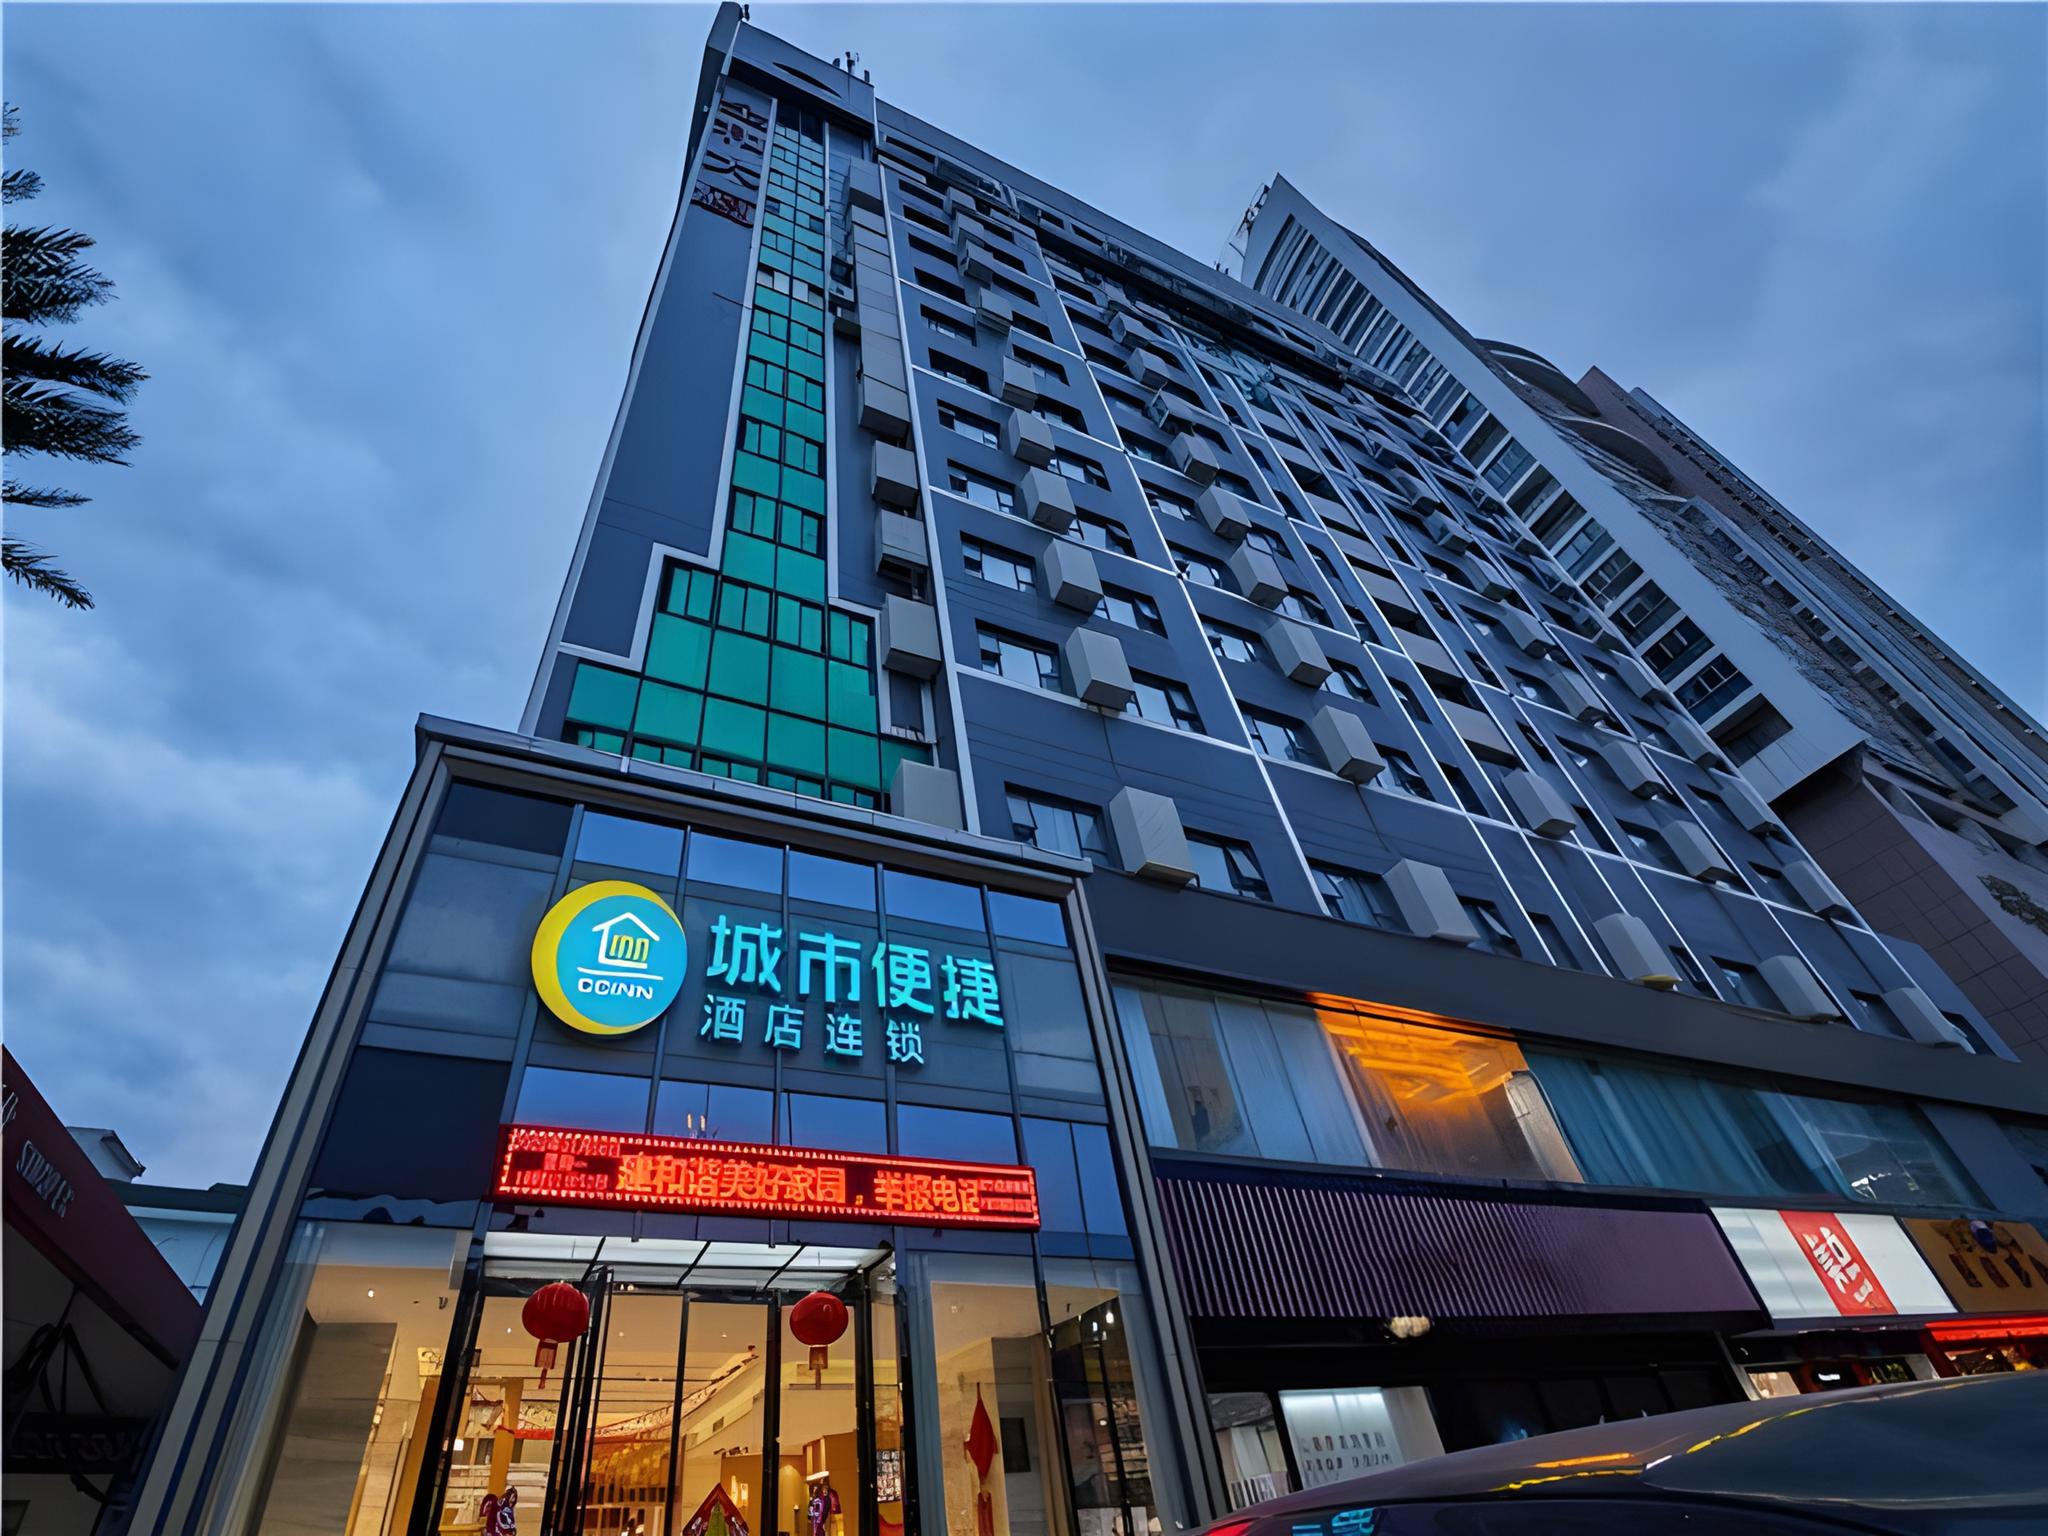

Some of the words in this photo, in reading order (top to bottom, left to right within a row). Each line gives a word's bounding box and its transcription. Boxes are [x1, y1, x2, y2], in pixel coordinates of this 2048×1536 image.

[706, 914, 1004, 1026] 城市便捷
[700, 993, 925, 1065] 酒店连锁
